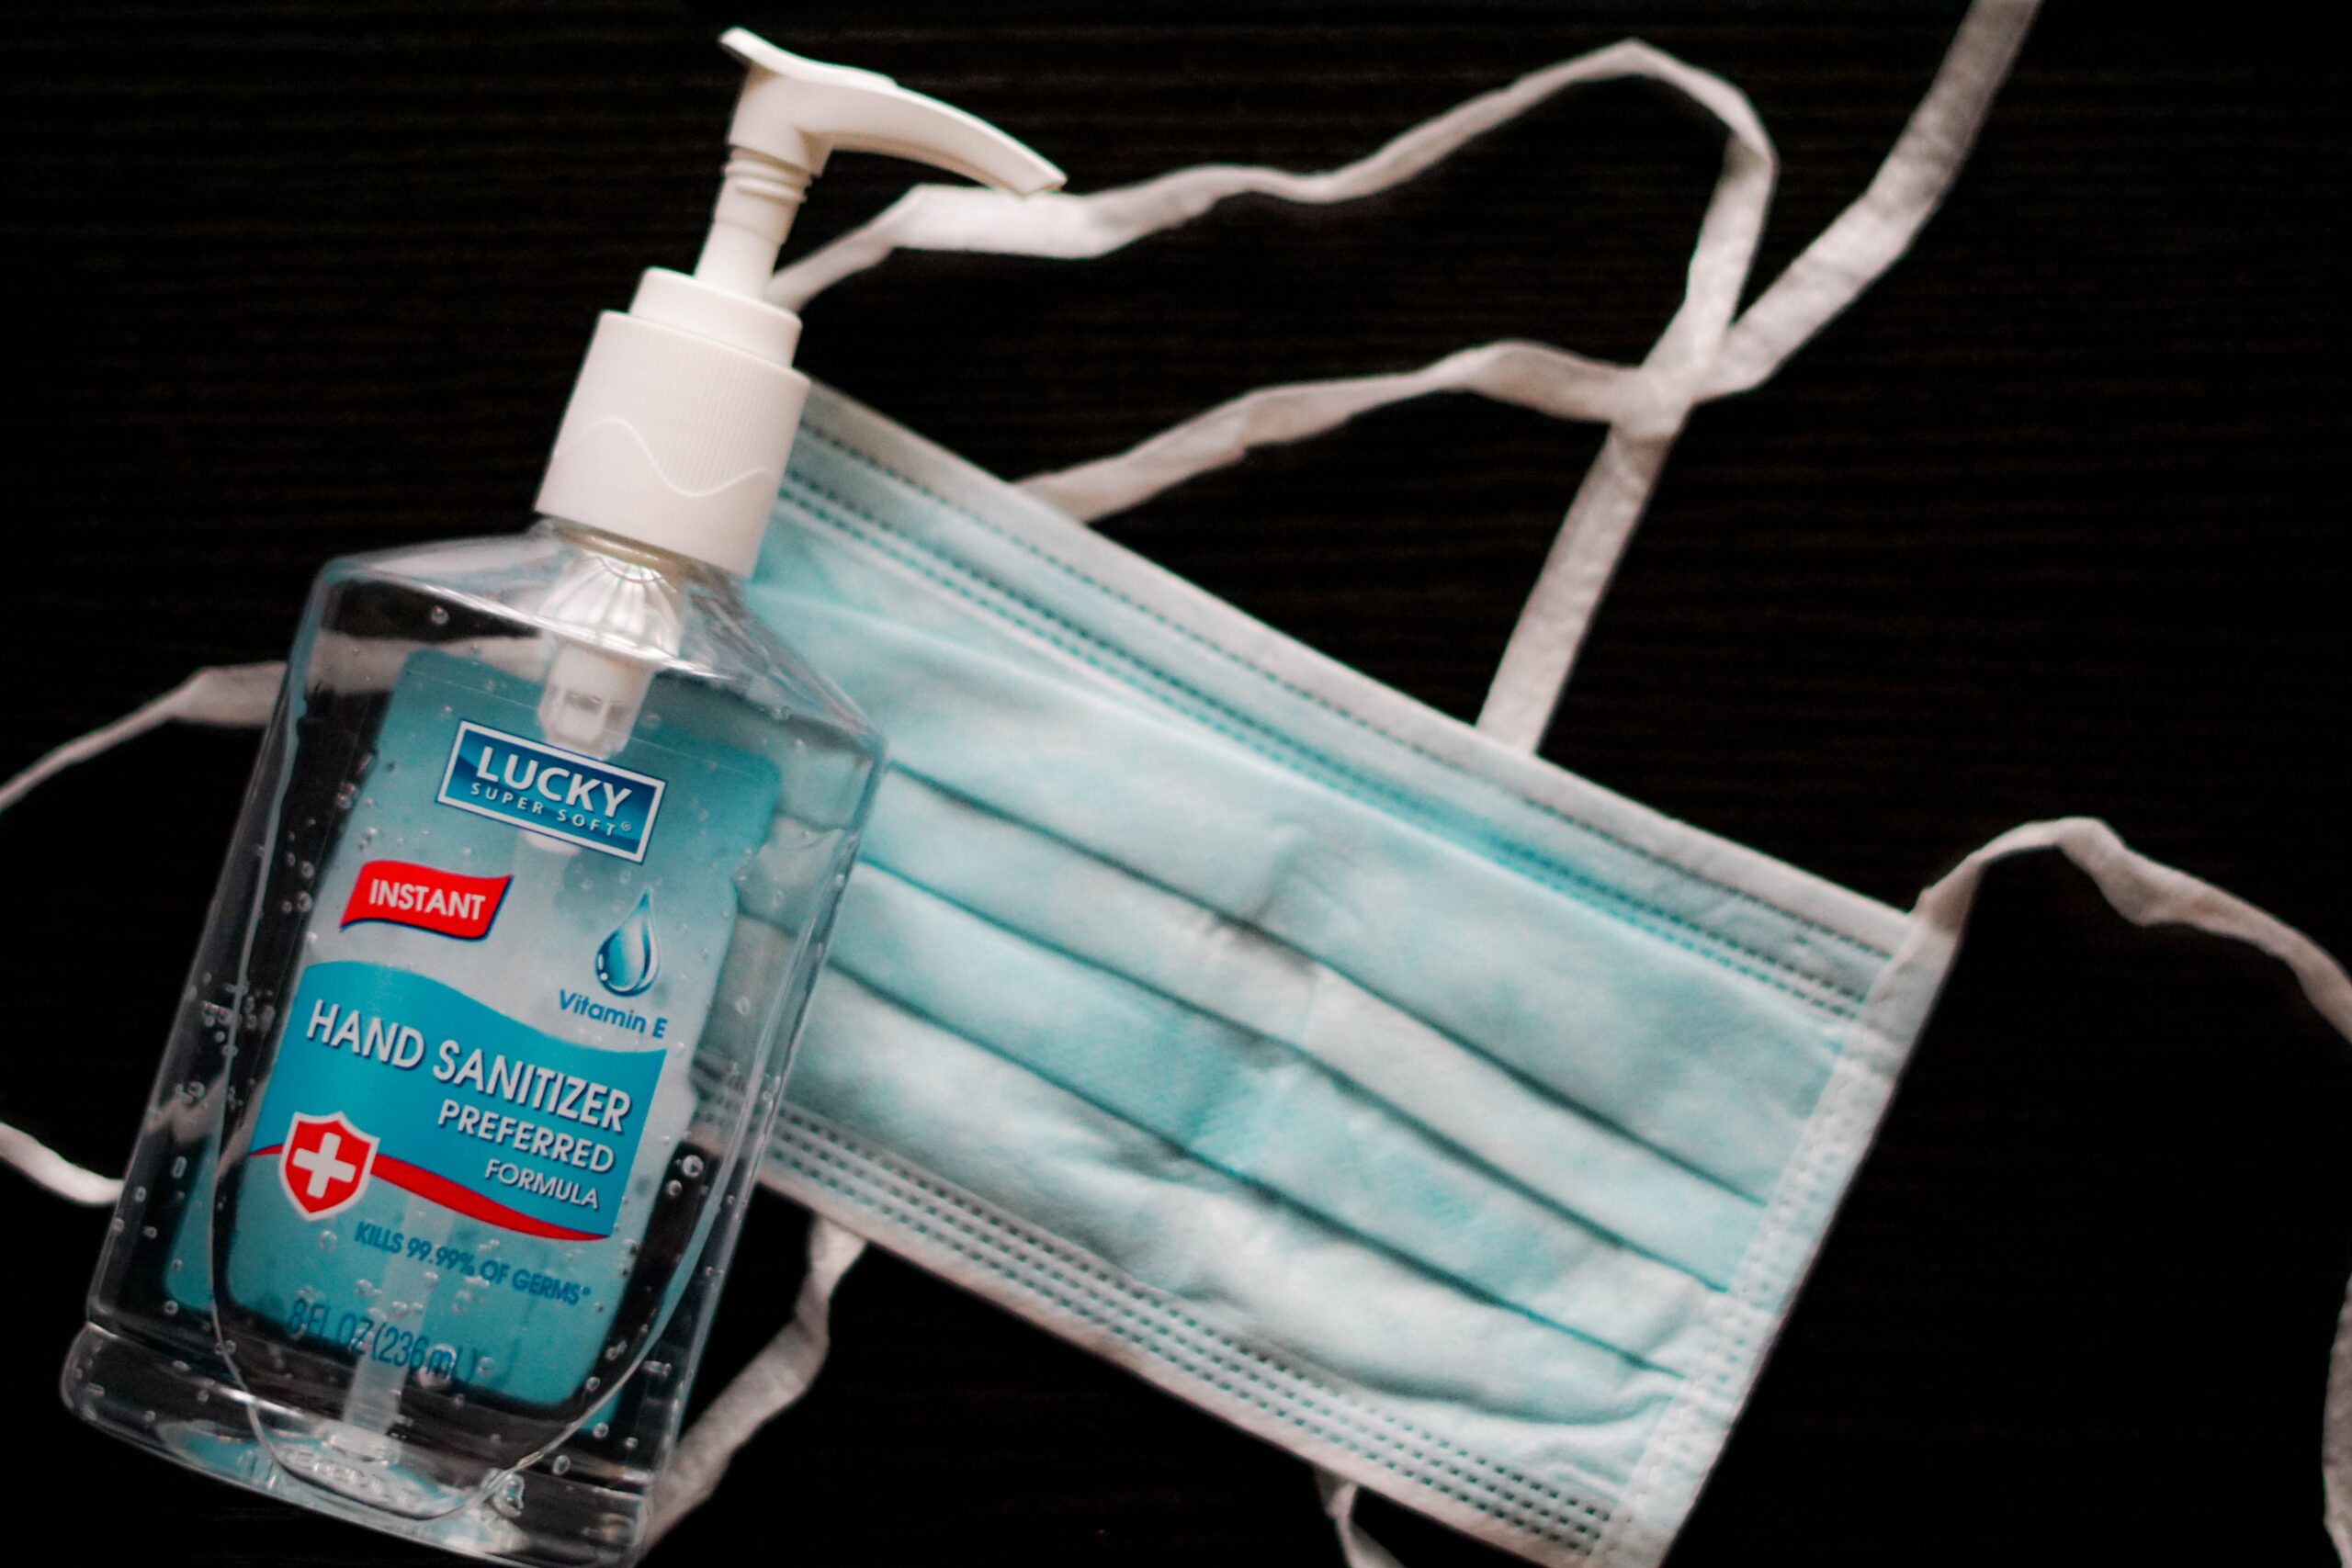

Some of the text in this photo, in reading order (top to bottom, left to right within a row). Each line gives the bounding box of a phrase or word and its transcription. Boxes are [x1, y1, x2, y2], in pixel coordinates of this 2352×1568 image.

[470, 783, 545, 815] SUPER
[476, 746, 632, 818] LUCKY
[369, 878, 486, 921] INSTANT
[560, 988, 668, 1039] Vitamin E
[306, 999, 632, 1134] HAND SANITIZER
[437, 1099, 616, 1174] PREFERRED
[485, 1159, 599, 1210] FORMULA
[355, 1221, 401, 1255] KILLS
[407, 1236, 476, 1277] 99.99%
[480, 1259, 509, 1283] OF
